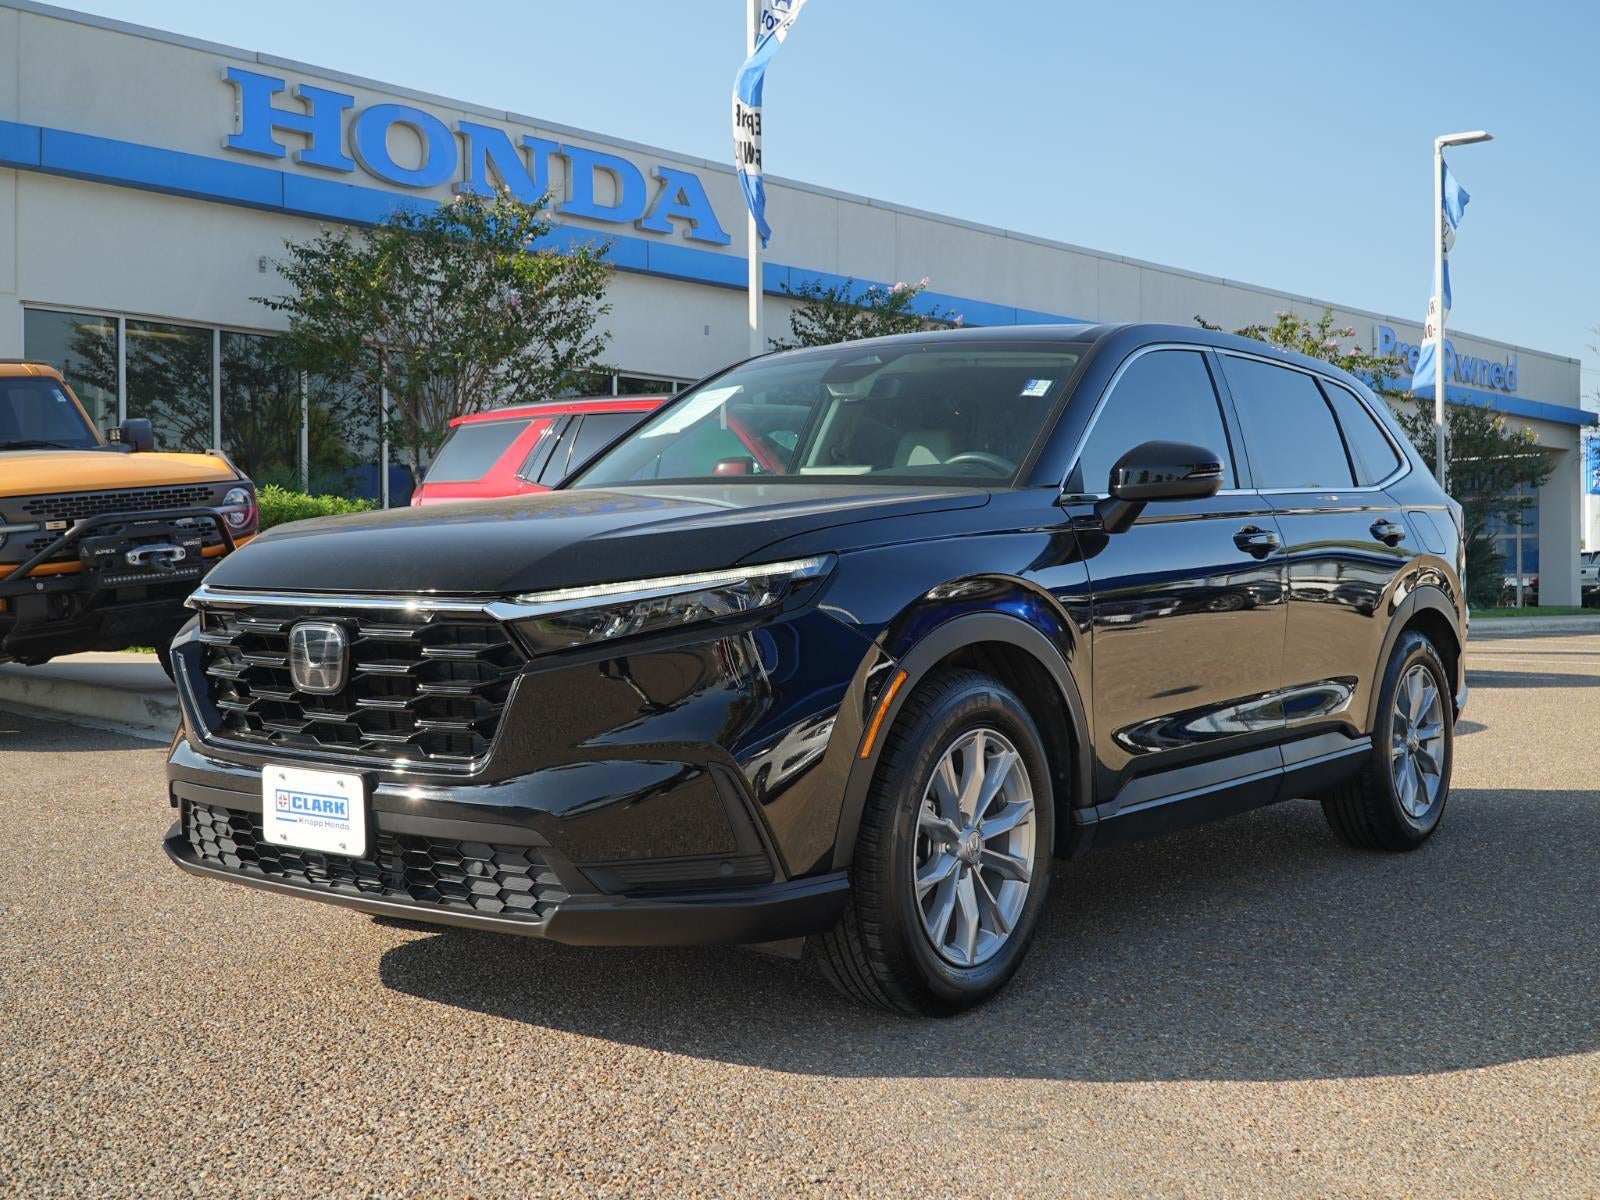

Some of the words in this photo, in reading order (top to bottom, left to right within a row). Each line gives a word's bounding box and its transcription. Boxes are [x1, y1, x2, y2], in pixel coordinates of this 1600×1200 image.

[222, 67, 731, 246] HONDA
[292, 796, 345, 815] CLARK
[298, 817, 324, 828] Knapp
[324, 820, 350, 831] Honda
